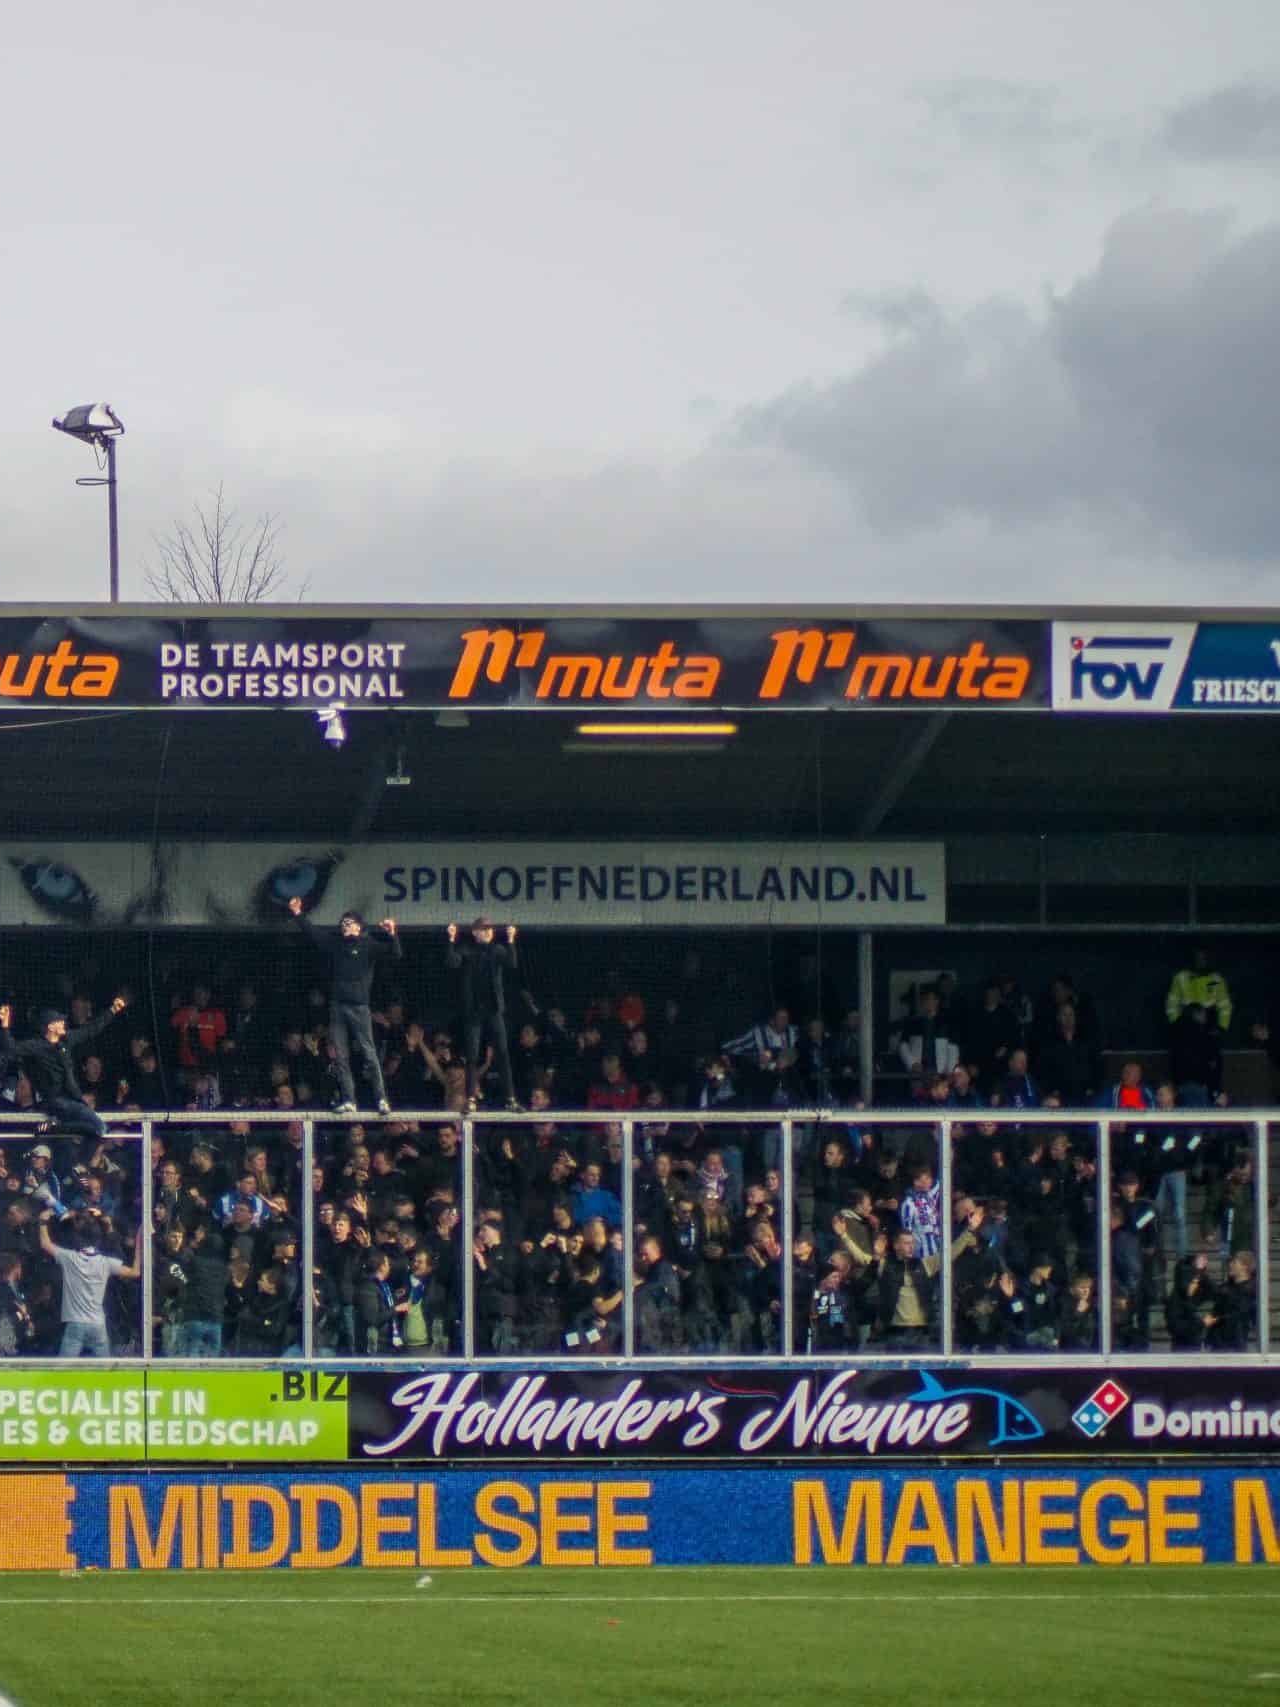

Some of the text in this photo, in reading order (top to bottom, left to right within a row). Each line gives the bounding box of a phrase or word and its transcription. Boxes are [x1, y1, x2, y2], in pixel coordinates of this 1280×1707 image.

[160, 643, 406, 669] DE TEAMSPORT
[535, 641, 723, 698] muta
[844, 642, 1031, 699] muta
[161, 673, 405, 698] PROFESSIONAL
[1192, 678, 1280, 703] FRIESC
[383, 865, 927, 904] SPINOFFNEDERLAND.NL
[170, 1390, 206, 1416] IN
[270, 1371, 347, 1402] .BIZ
[362, 1369, 970, 1457] Hollander's Nieuwe
[47, 1419, 70, 1446] &
[79, 1419, 319, 1447] GEREEDSCHAP
[108, 1481, 654, 1568] MIDDELSEE
[793, 1479, 1204, 1564] MANEGE
